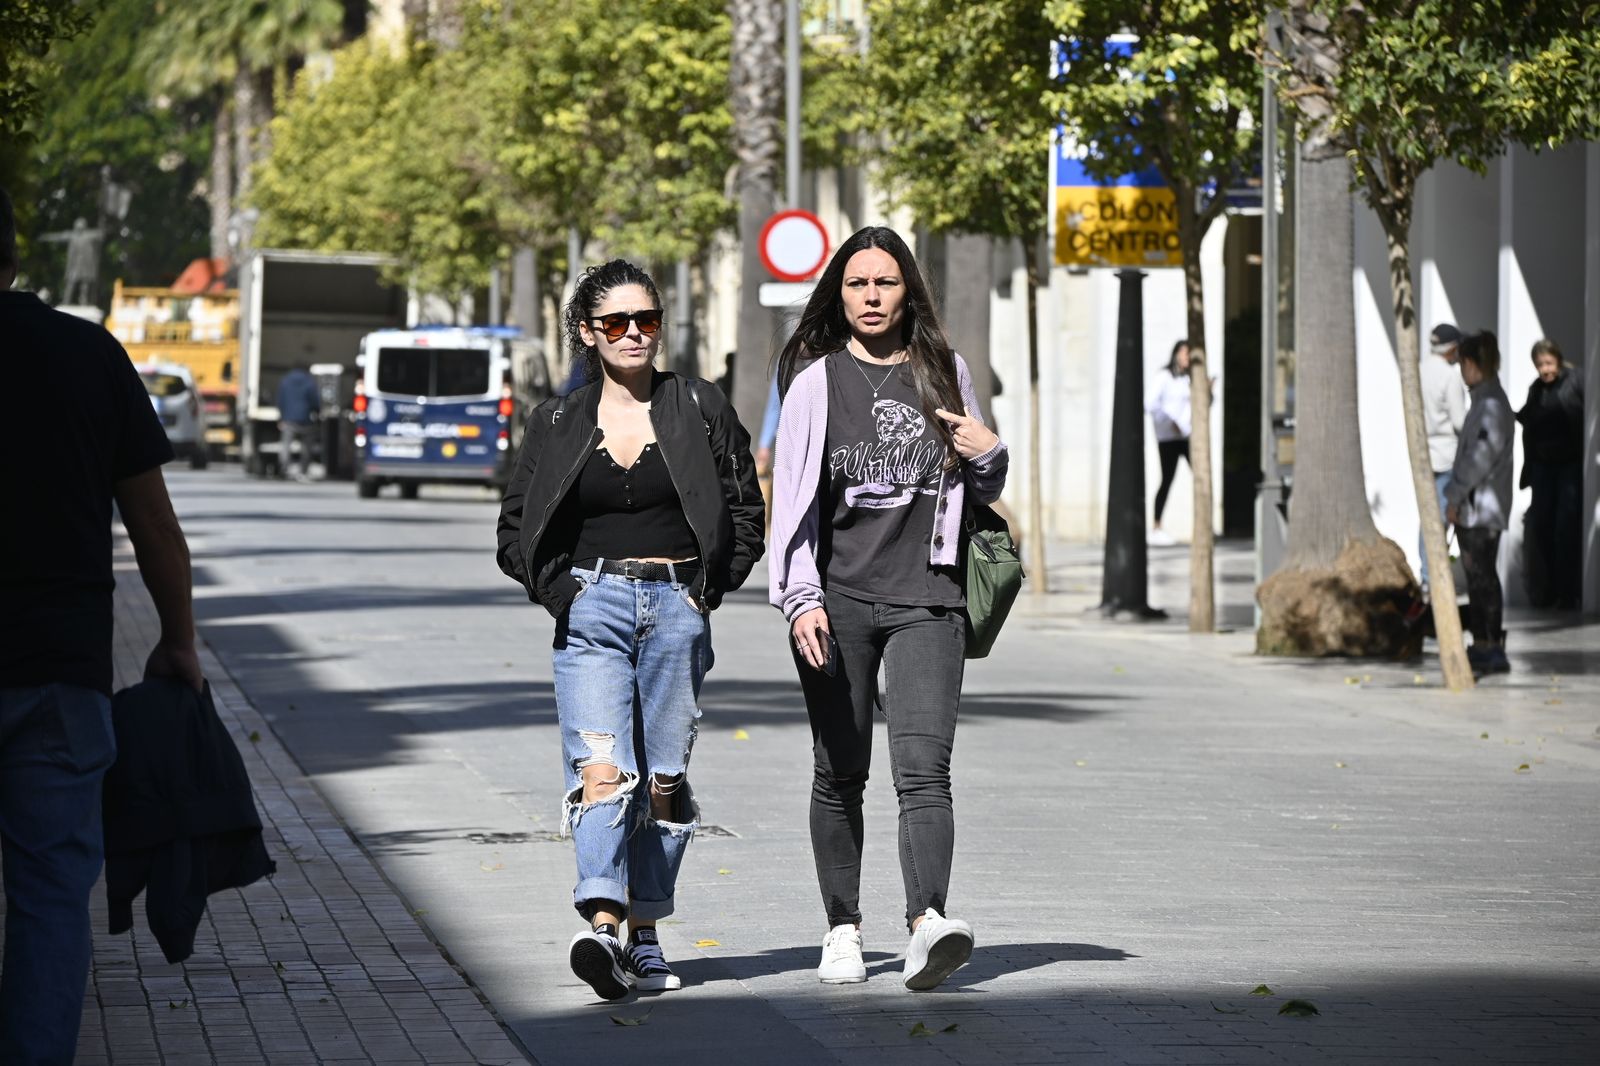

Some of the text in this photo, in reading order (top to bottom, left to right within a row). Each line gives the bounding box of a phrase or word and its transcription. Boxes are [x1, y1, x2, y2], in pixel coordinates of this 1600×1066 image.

[1070, 230, 1180, 252] CENTRO
[830, 440, 946, 484] POISONOU
[863, 465, 920, 484] MINDS
